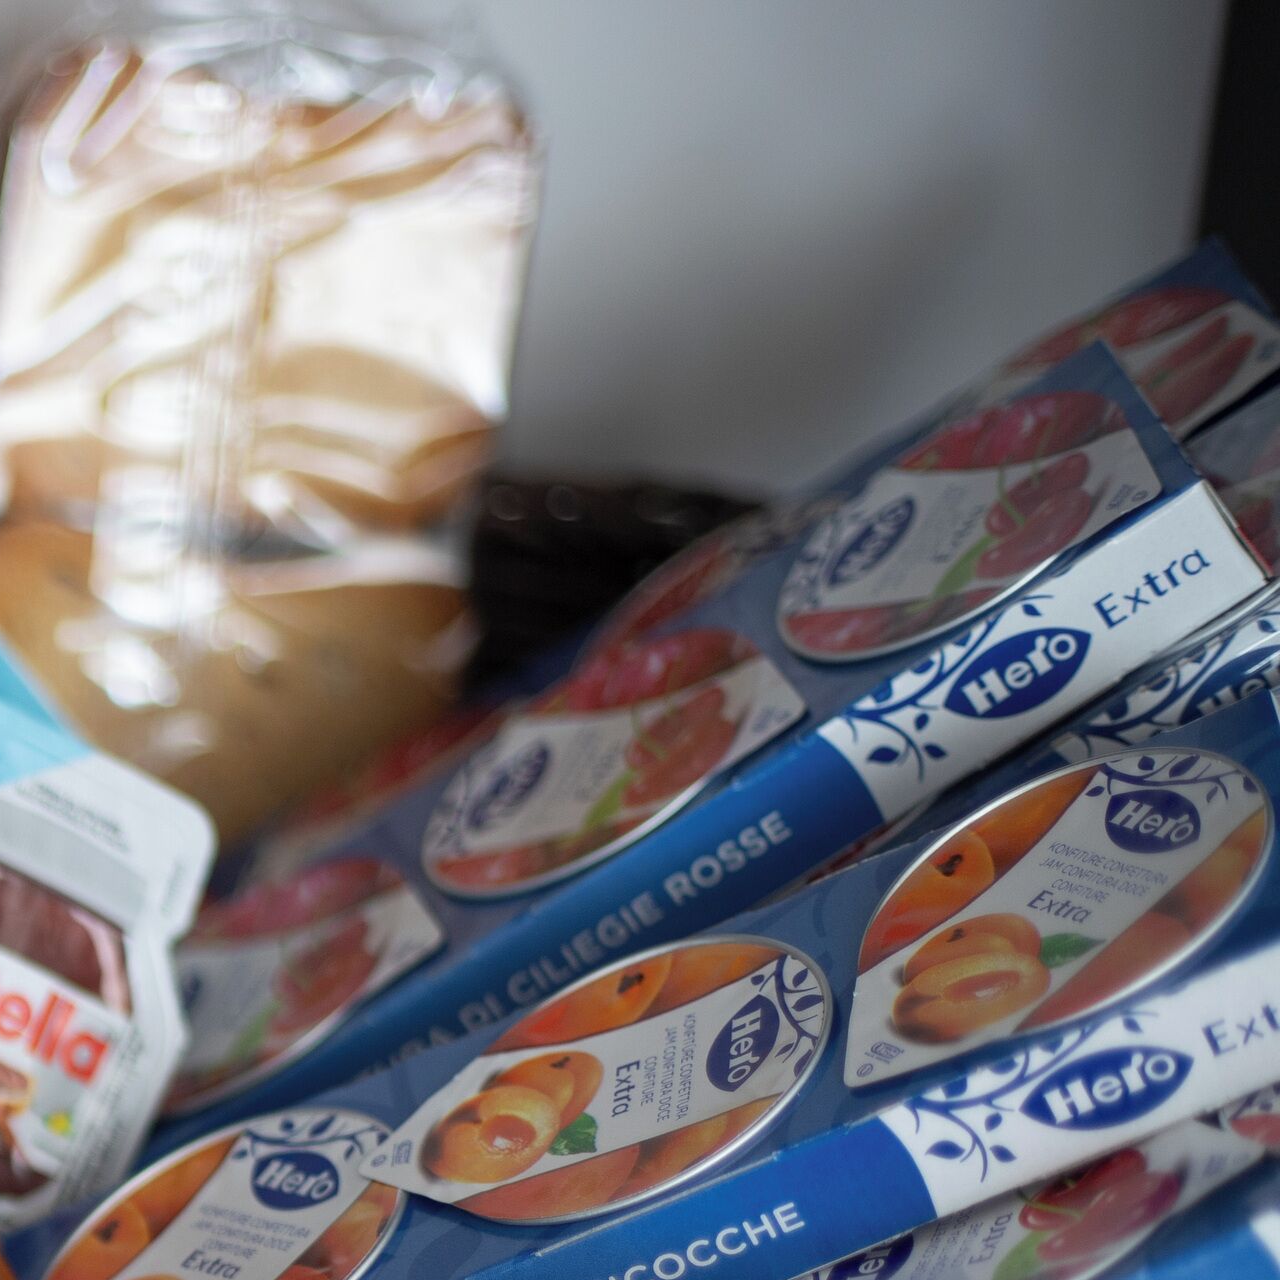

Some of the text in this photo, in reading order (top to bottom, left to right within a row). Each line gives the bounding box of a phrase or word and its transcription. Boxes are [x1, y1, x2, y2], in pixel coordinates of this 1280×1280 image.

[963, 550, 1210, 712] Hero Extra
[1112, 800, 1192, 842] Hero
[1039, 858, 1063, 871] JAM
[509, 892, 660, 1002] CILIEGIE
[665, 812, 789, 900] ROSSE
[1028, 890, 1090, 924] Extra
[660, 1046, 677, 1096] CONFITURA
[729, 1010, 760, 1082] Hero
[1046, 1005, 1276, 1124] Hero Ext
[612, 1060, 640, 1117] Extra
[640, 1056, 658, 1107] CONFITURE
[676, 1063, 693, 1120] CONFETTURA
[656, 1096, 671, 1123] DOCE
[256, 1160, 332, 1199] Hero
[968, 1212, 1012, 1264] Extra
[182, 1250, 240, 1279] Extra
